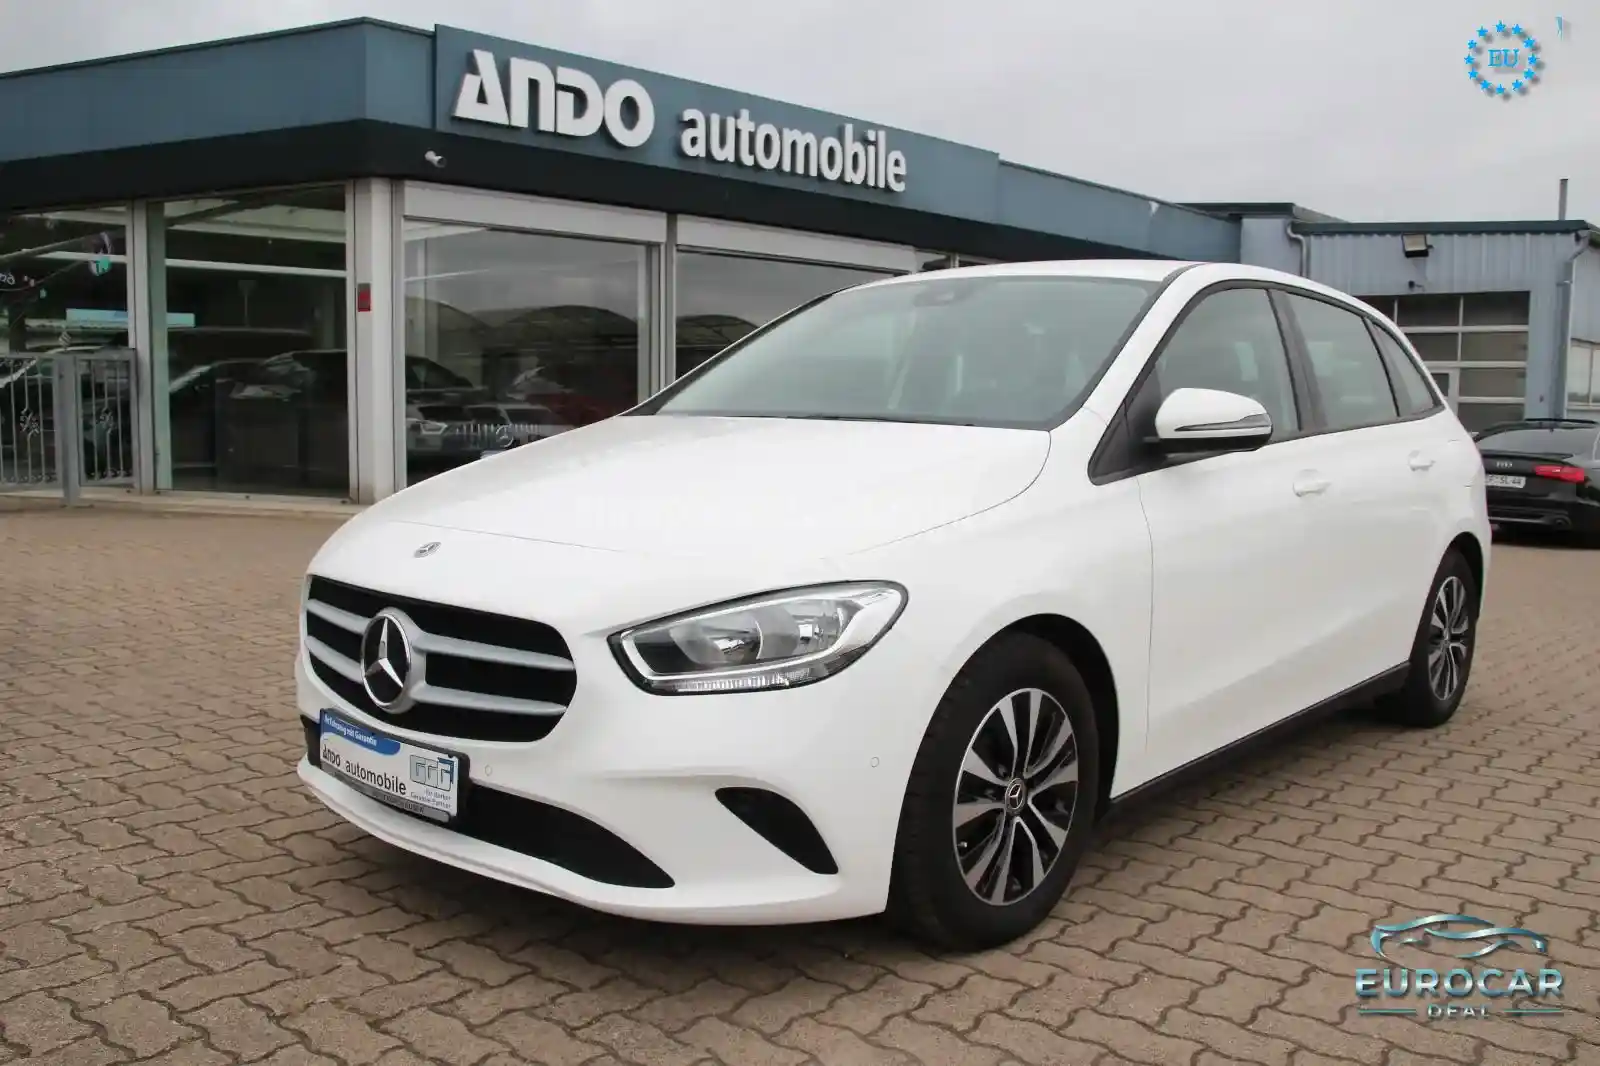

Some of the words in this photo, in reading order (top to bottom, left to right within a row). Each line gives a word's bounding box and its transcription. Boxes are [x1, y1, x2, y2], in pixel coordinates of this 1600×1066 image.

[450, 48, 656, 148] ANDO
[678, 106, 907, 193] automobile
[345, 758, 407, 796] automobile
